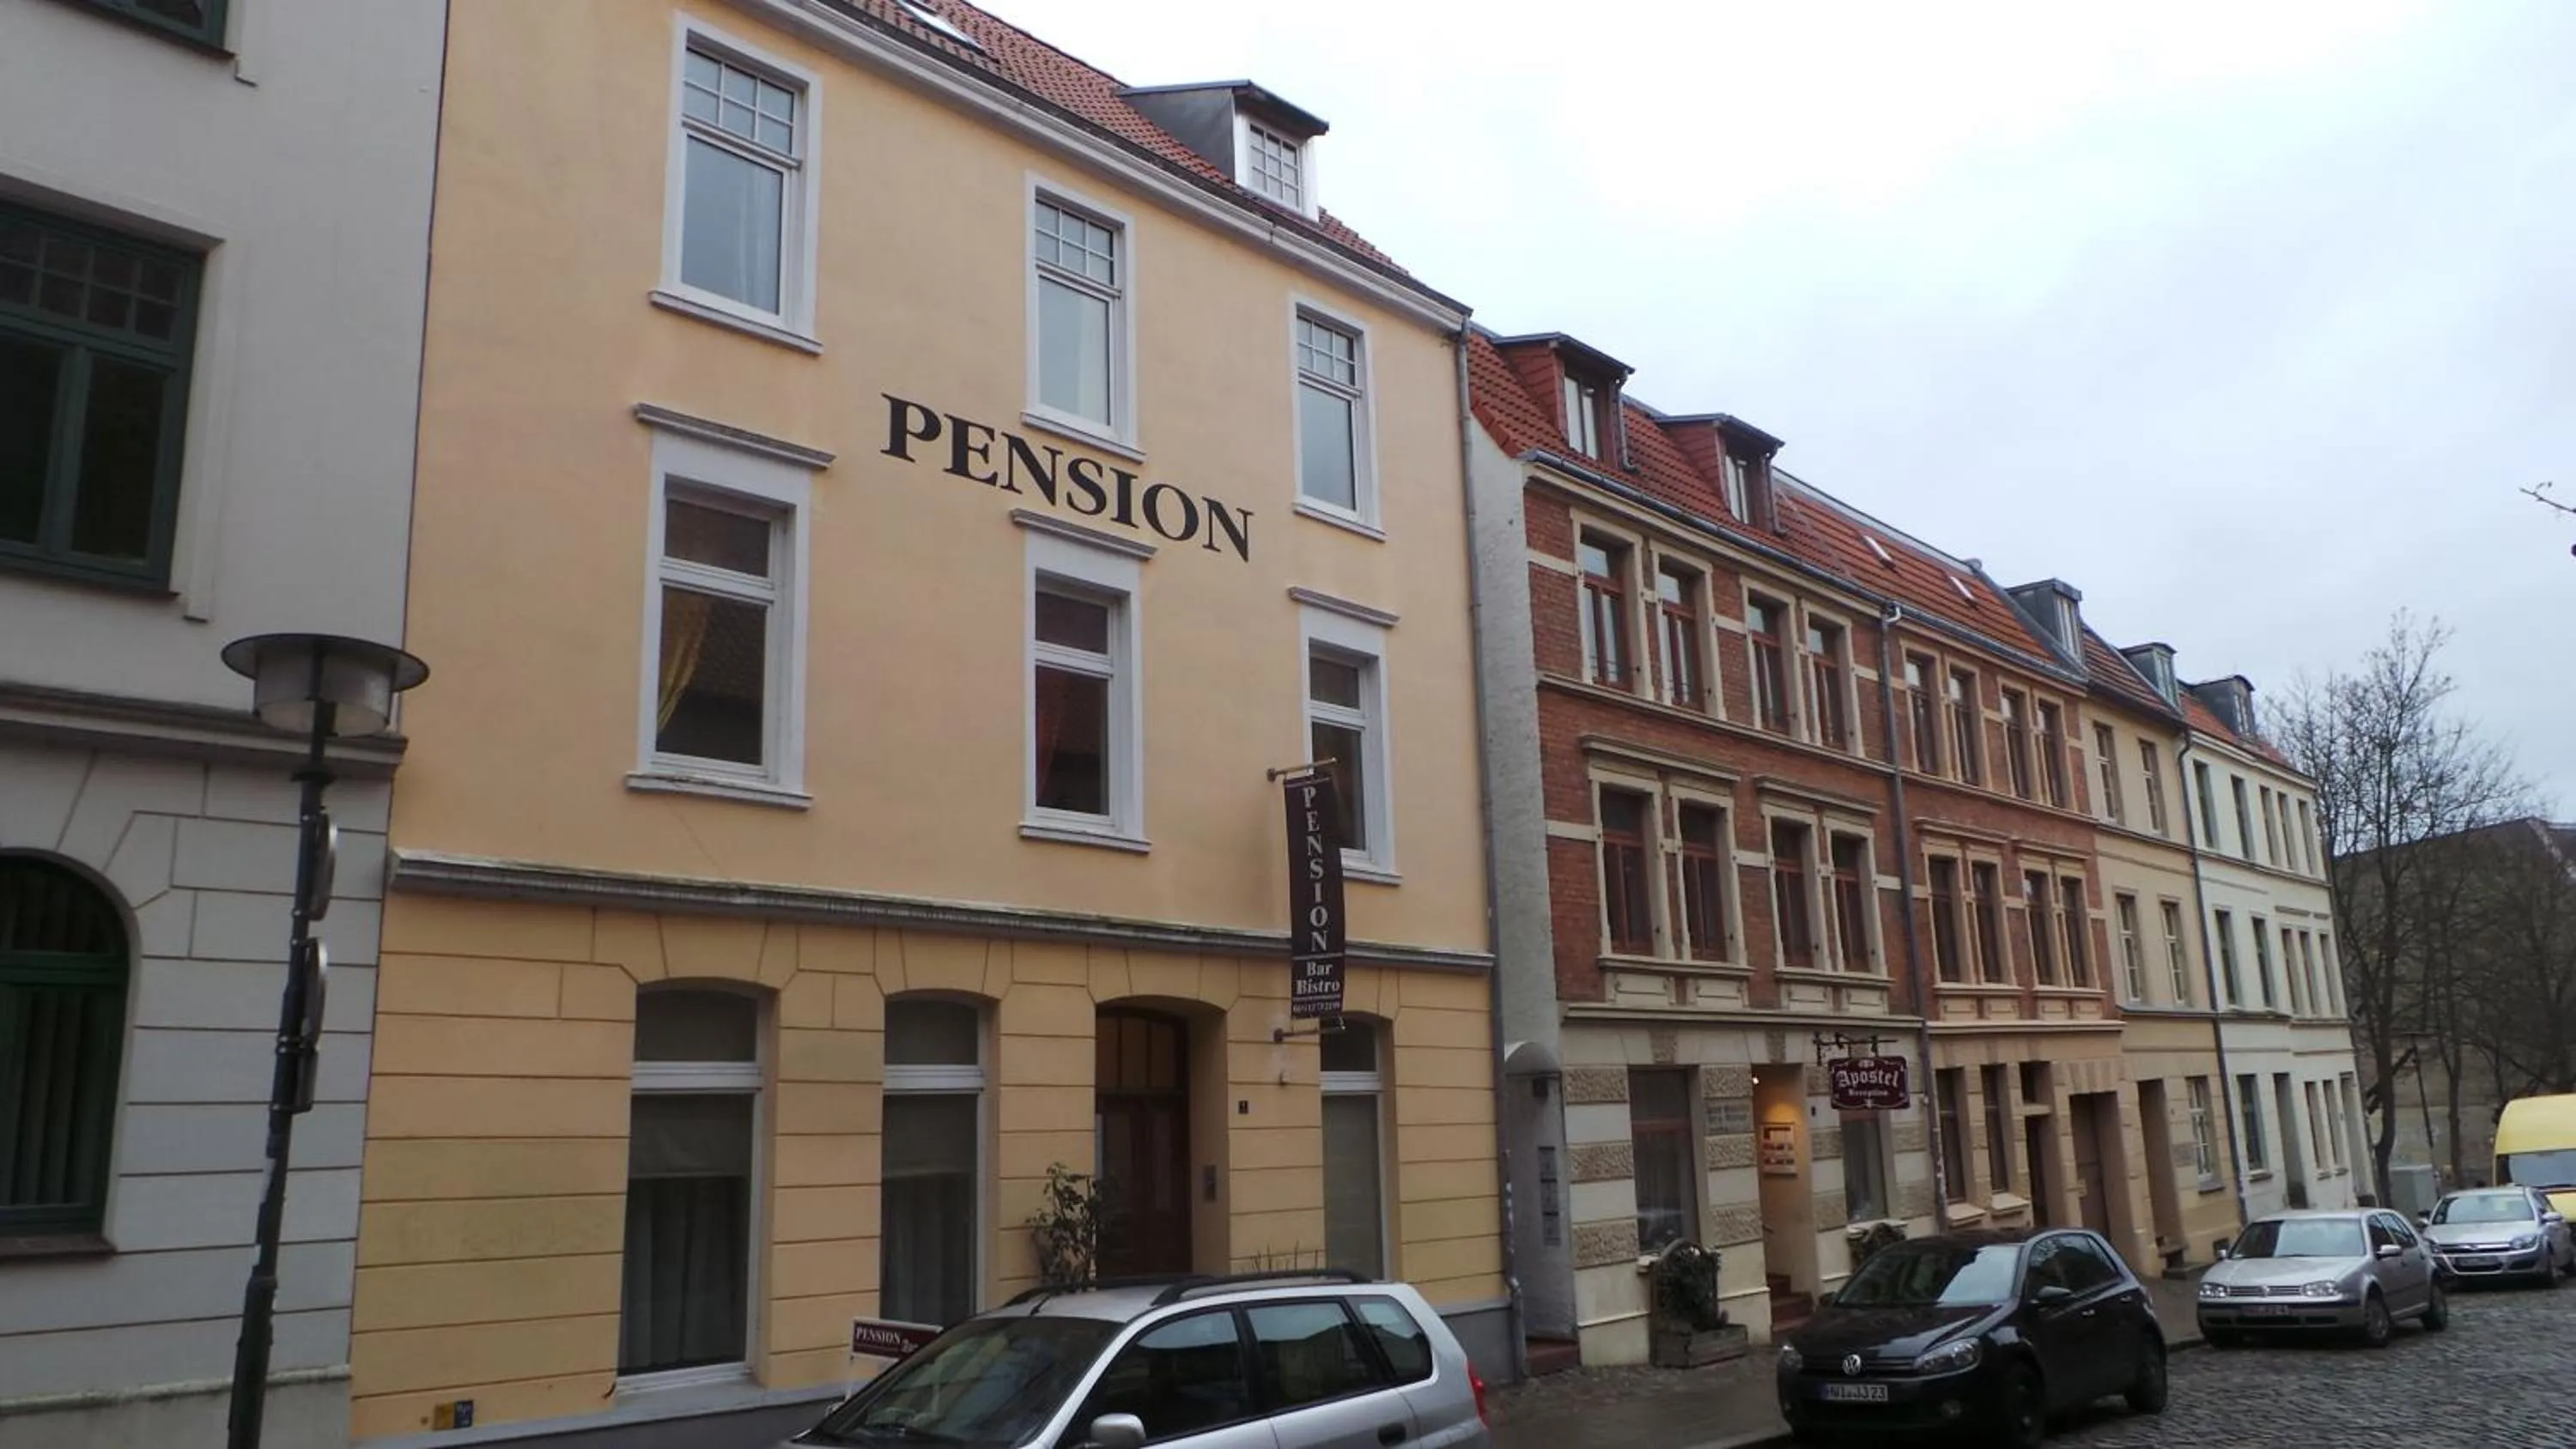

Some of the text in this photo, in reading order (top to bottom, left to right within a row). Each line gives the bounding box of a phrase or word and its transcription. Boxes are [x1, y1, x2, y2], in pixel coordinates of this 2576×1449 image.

[880, 392, 1254, 563] PENSION
[1303, 785, 1329, 952] PENSION
[1306, 961, 1334, 976] Bar
[1296, 978, 1341, 995] Bistro
[1835, 1070, 1899, 1088] Apostel
[855, 1326, 901, 1345] PENSION
